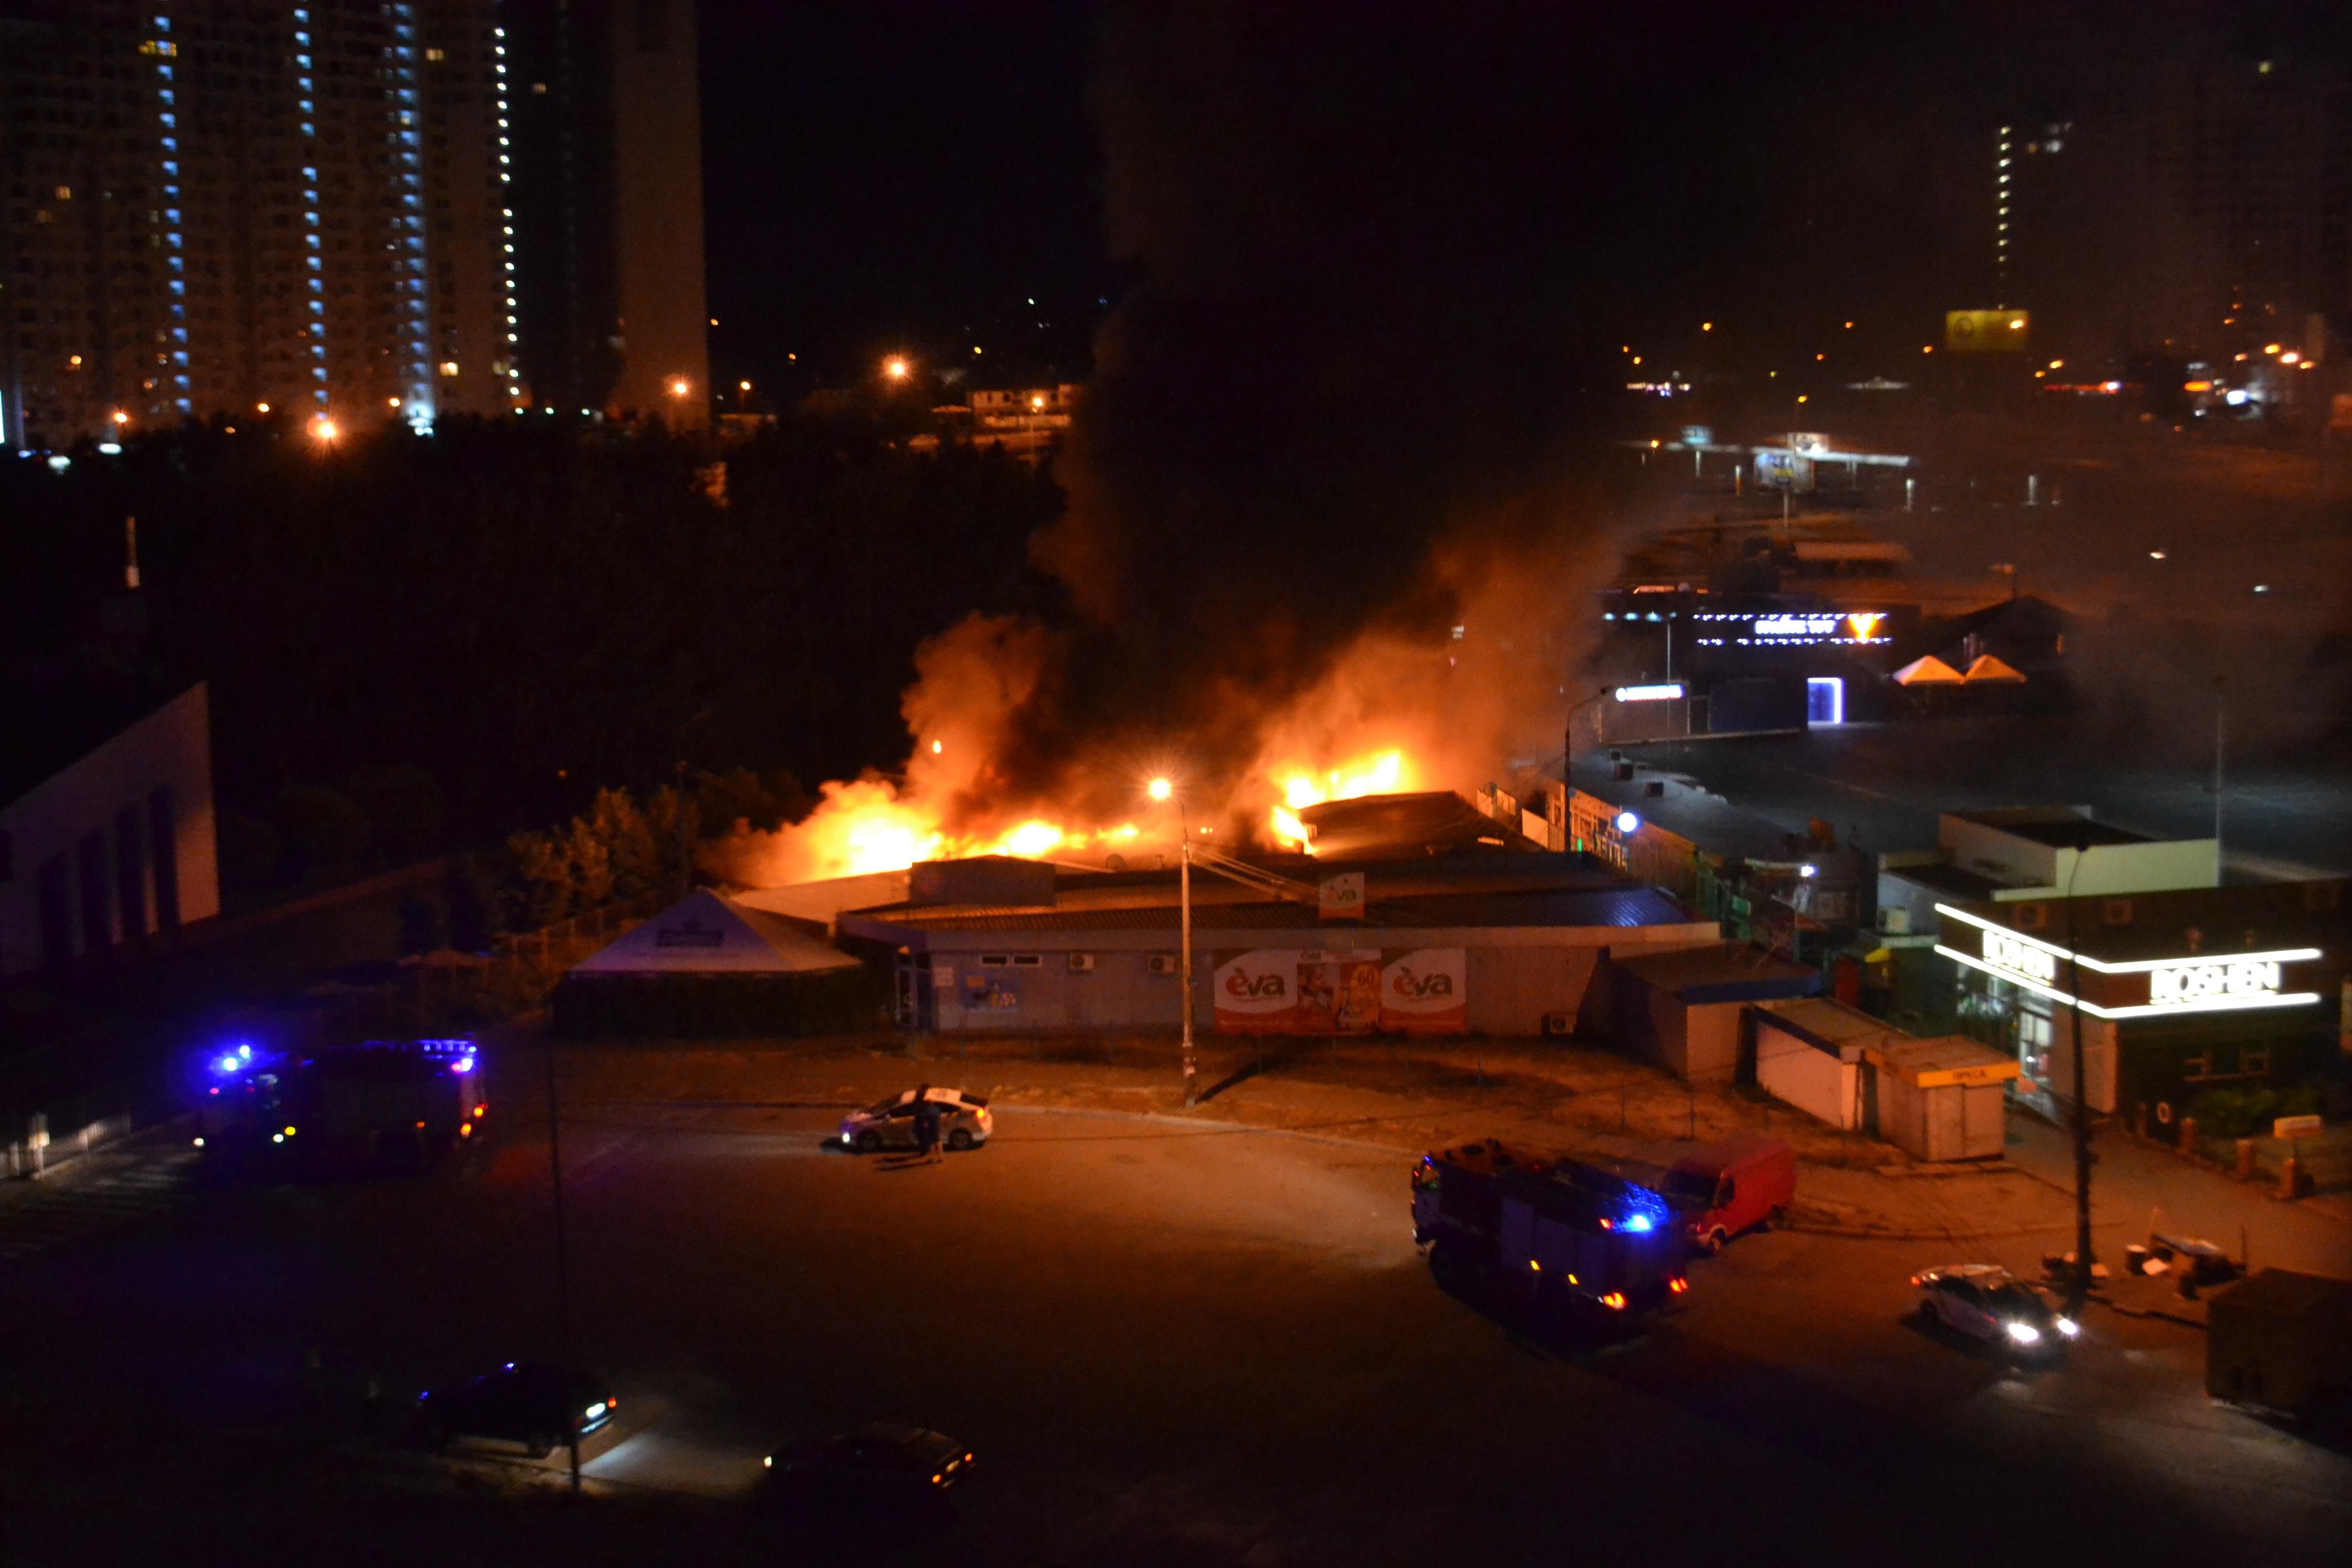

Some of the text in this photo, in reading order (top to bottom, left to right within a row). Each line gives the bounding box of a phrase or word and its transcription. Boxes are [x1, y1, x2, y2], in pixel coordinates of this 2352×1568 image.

[1226, 966, 1285, 997] èva
[1392, 966, 1453, 997] èva
[2151, 961, 2280, 998] ROSHEN
